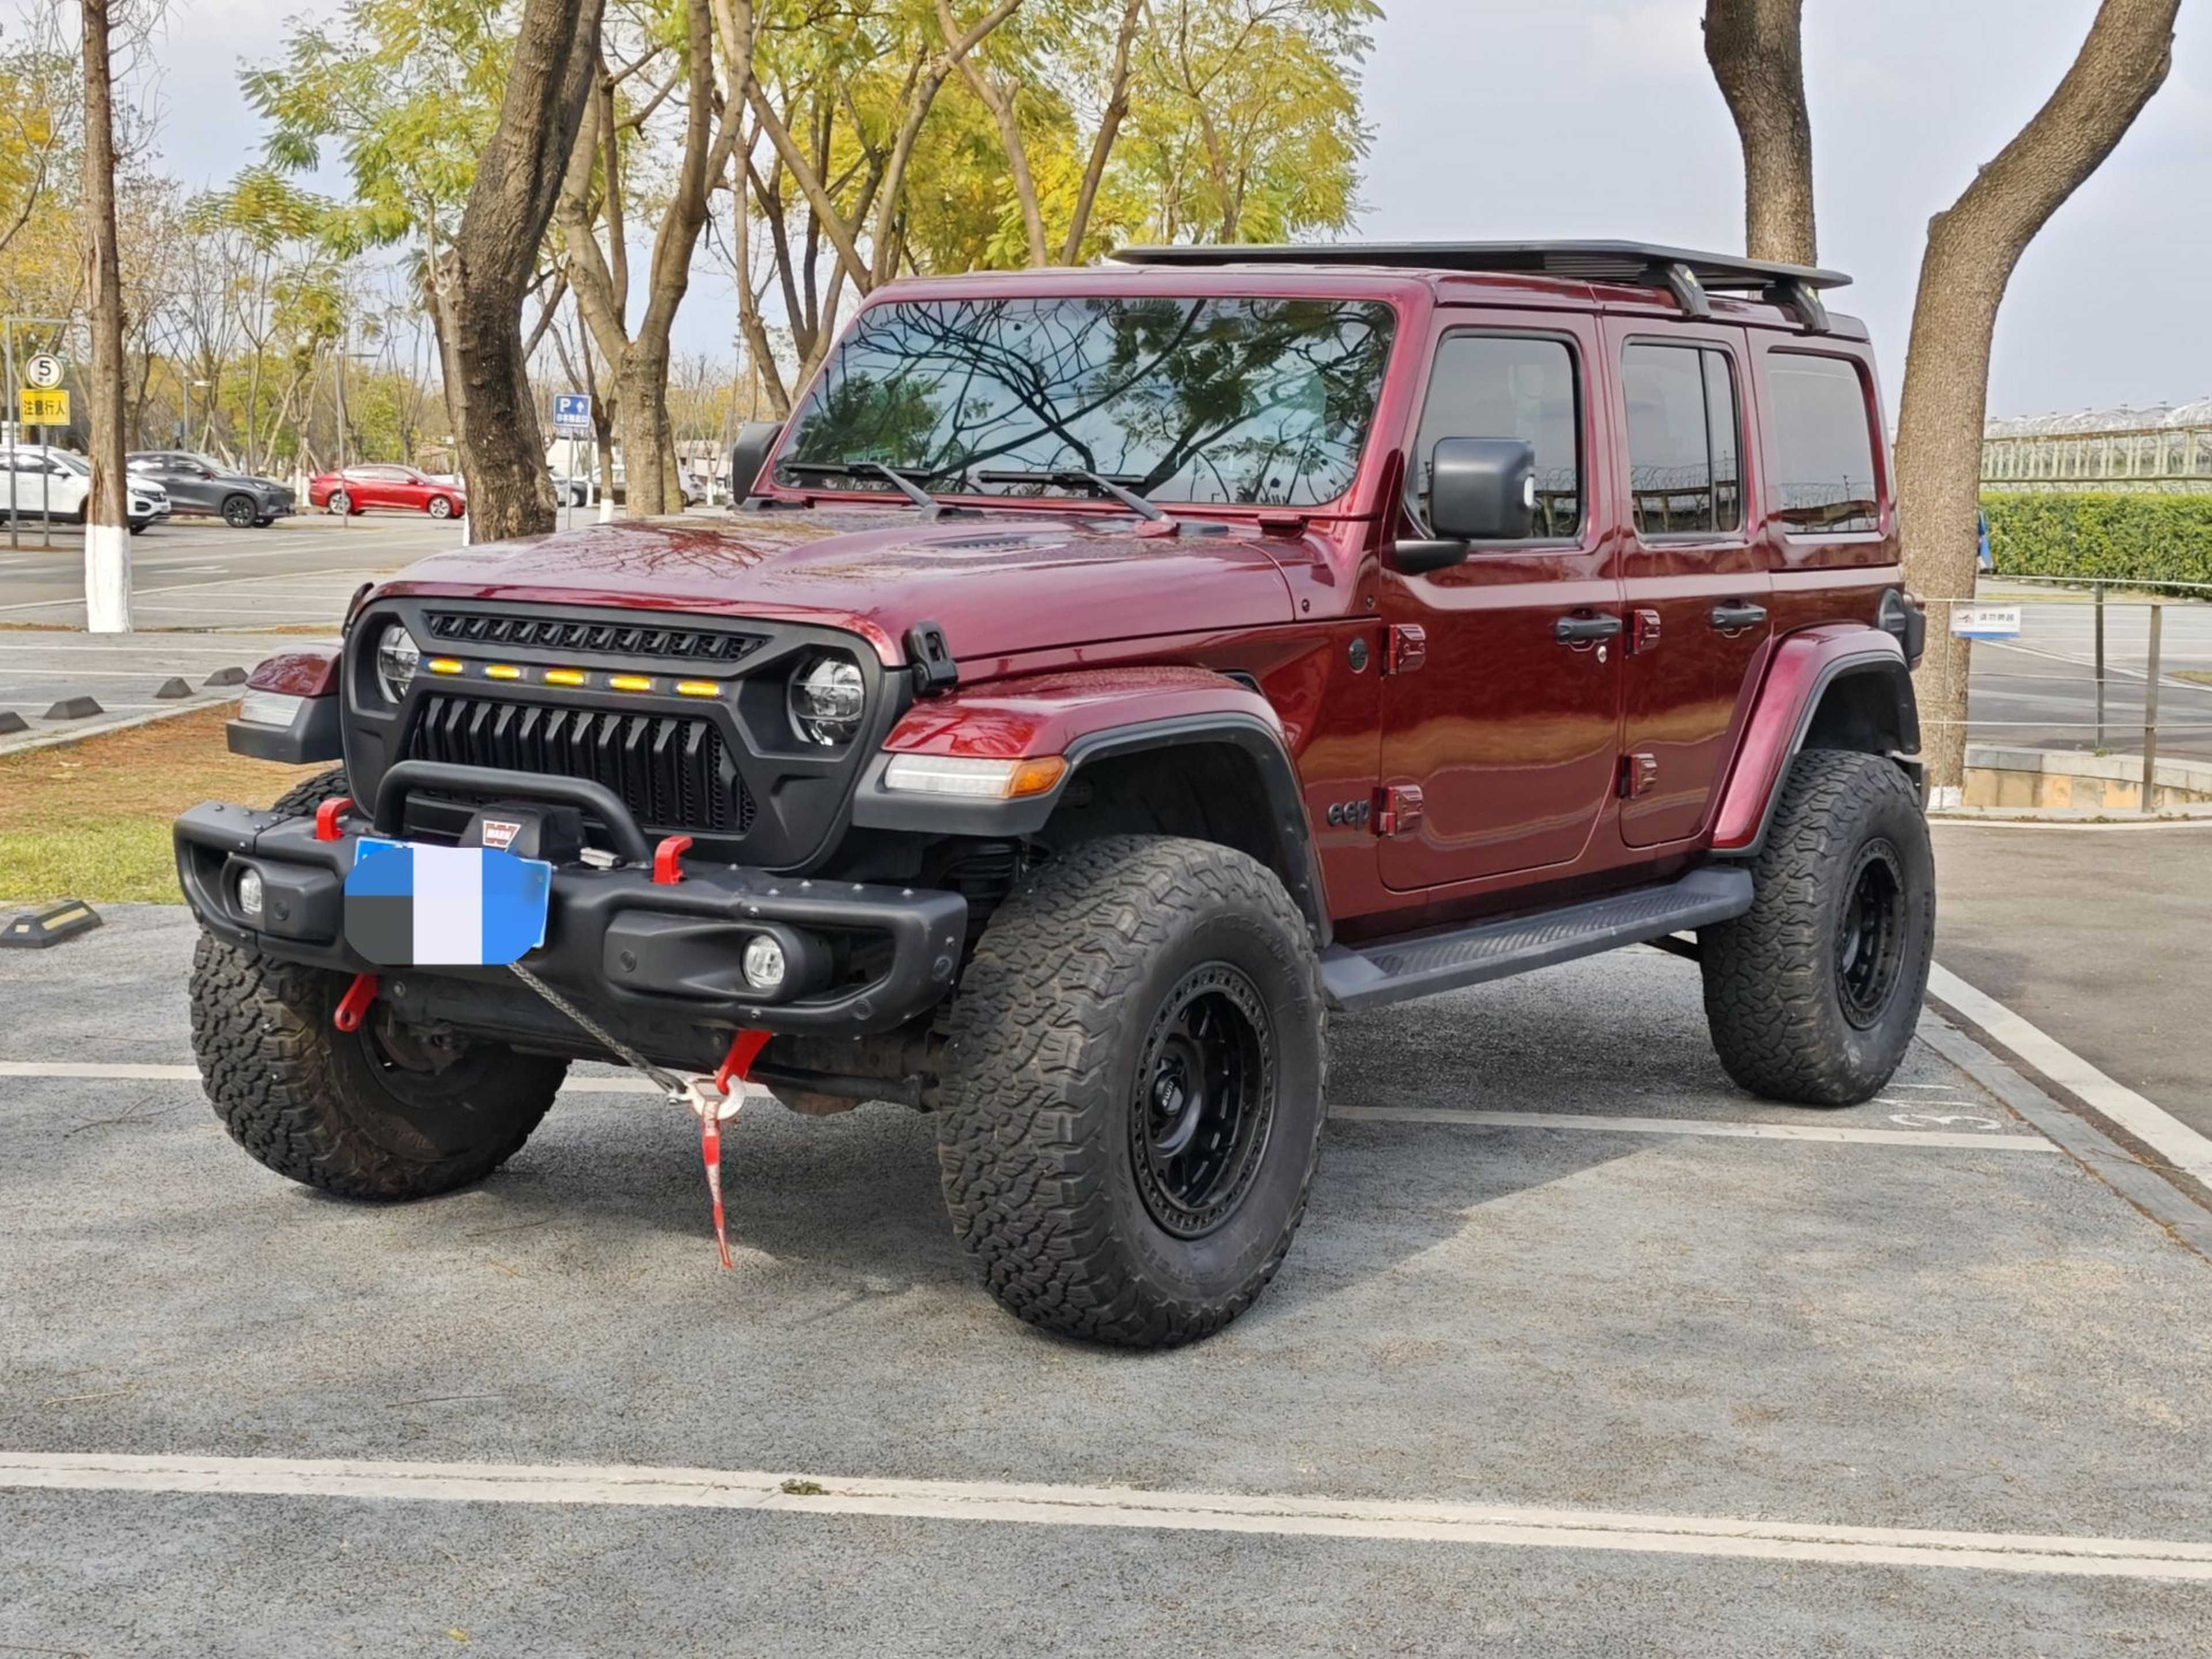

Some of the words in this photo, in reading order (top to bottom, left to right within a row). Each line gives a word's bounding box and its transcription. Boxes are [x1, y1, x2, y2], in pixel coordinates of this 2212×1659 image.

[39, 360, 51, 376] 5
[24, 400, 65, 415] 注意行人
[560, 398, 571, 412] P
